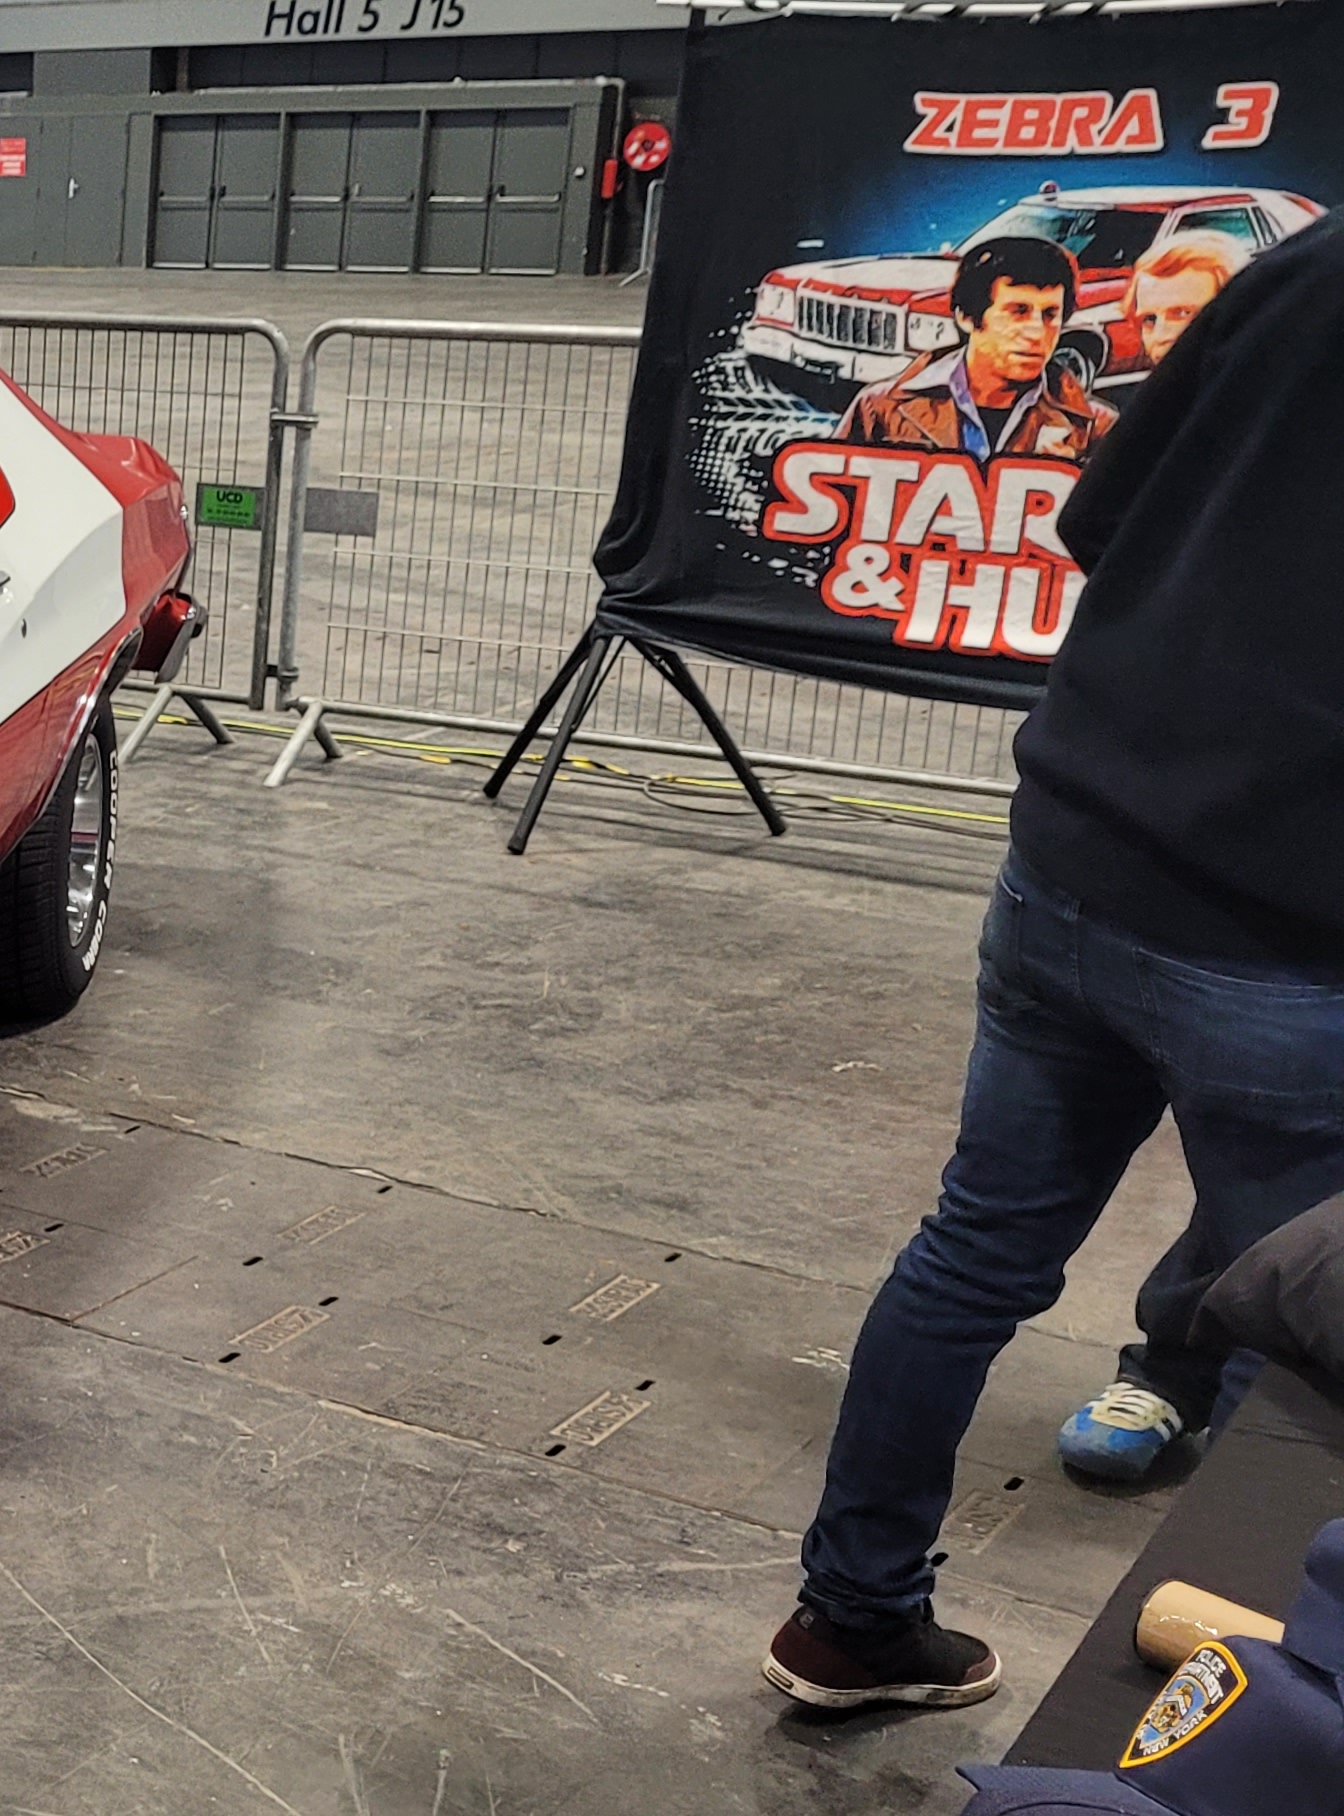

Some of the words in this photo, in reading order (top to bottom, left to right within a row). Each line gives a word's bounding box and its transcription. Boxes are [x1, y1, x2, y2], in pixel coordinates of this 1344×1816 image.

[264, 0, 346, 37] Hall
[358, 0, 380, 33] 5
[400, 0, 465, 31] J15
[905, 91, 1163, 154] ZEBRA
[1202, 82, 1278, 148] 3
[216, 490, 244, 504] UCD
[769, 447, 1080, 561] STAR
[827, 541, 907, 612] &
[81, 899, 108, 972] COBRA
[1194, 1648, 1227, 1679] POLICE
[1142, 1736, 1171, 1756] NEW
[1172, 1708, 1209, 1741] YORK
